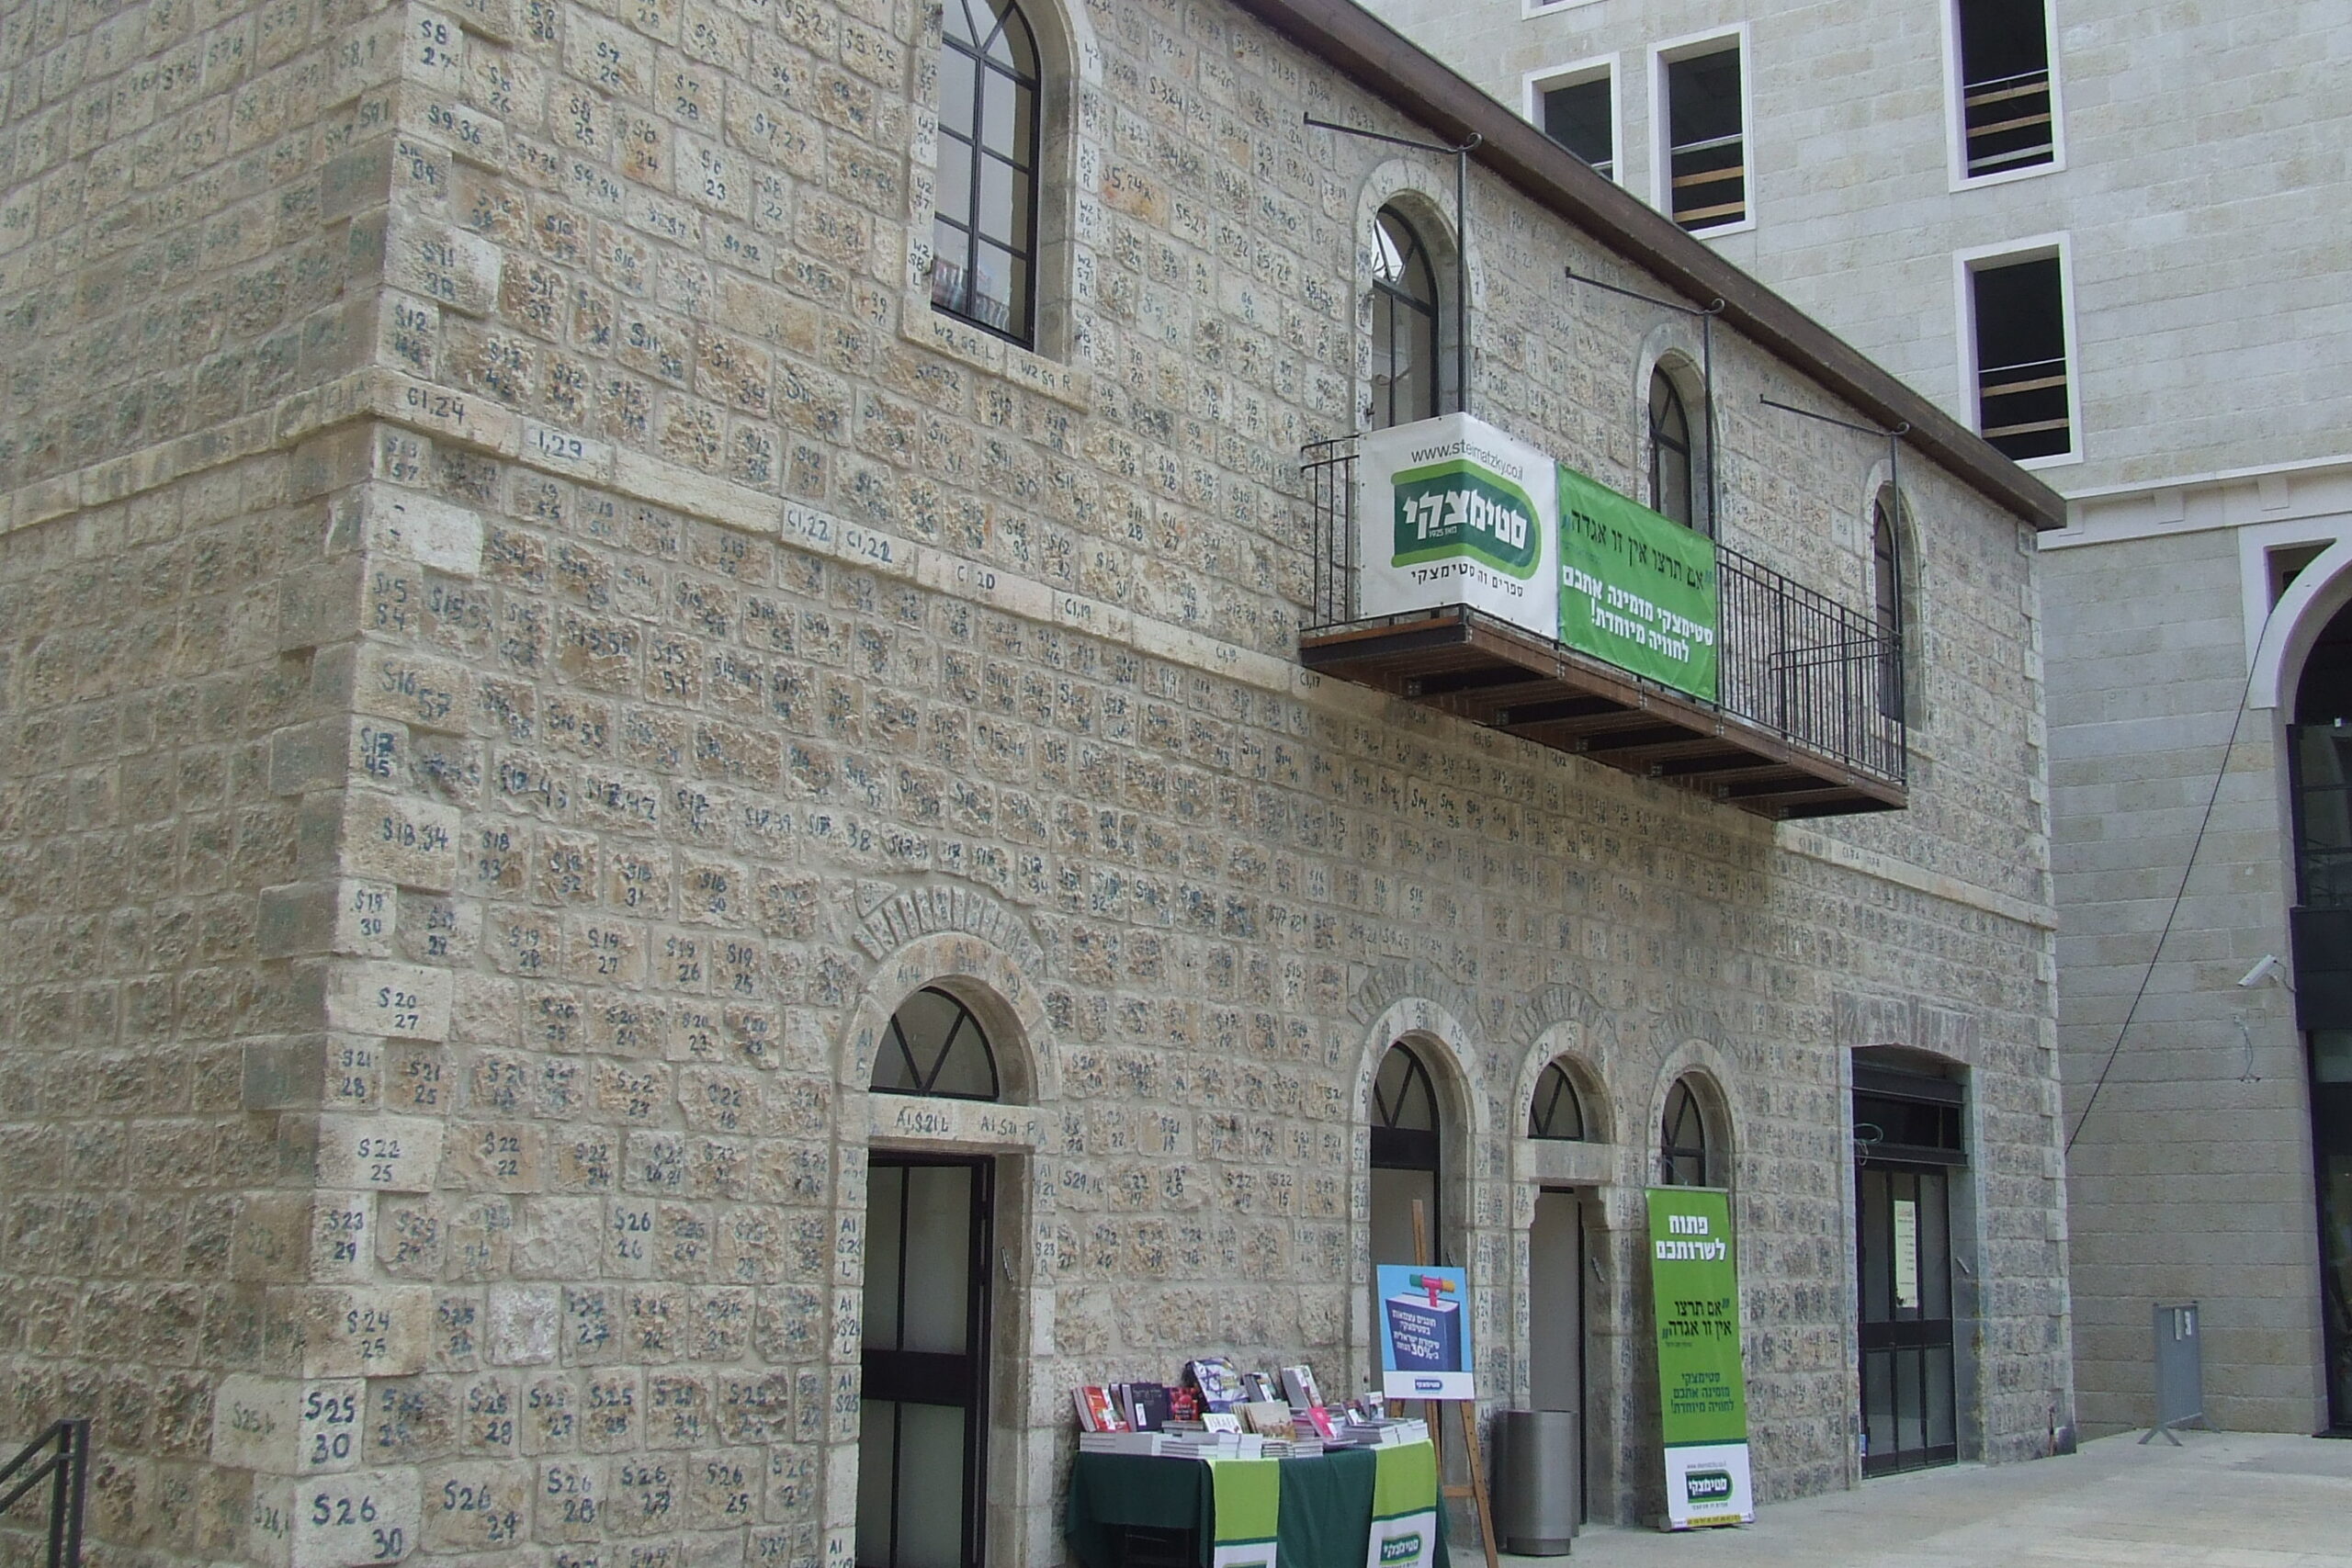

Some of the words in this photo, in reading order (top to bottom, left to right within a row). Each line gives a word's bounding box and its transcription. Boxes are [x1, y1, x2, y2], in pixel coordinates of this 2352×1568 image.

[422, 20, 447, 44] S8
[675, 96, 698, 120] 28
[706, 179, 726, 201] 23
[1021, 359, 1037, 378] W2
[1411, 439, 1523, 481] www.steimatzky.co.il
[1402, 489, 1528, 549] סטימצקי
[1628, 536, 1647, 567] אין
[1411, 563, 1475, 585] סטימצקי
[1563, 565, 1602, 600] אתכם
[1492, 579, 1523, 597] ספרים
[1657, 607, 1713, 646] סטימצקי
[479, 859, 501, 882] 33
[360, 919, 382, 936] 30
[598, 956, 617, 975] 27
[379, 987, 417, 1008] S20
[394, 1013, 419, 1031] 27
[689, 1034, 707, 1051] 23
[343, 1049, 371, 1067] S21
[410, 1061, 441, 1081] S21
[341, 1077, 366, 1098] 28
[415, 1085, 436, 1104] 25
[357, 1138, 400, 1158] S22
[485, 1132, 520, 1155] S22
[370, 1164, 392, 1182] 25
[497, 1159, 518, 1177] 22
[1668, 1215, 1709, 1235] פתוח
[1656, 1238, 1726, 1260] לשרותכם
[1675, 1301, 1704, 1315] תרצו
[347, 1310, 390, 1334] S24
[1714, 1321, 1732, 1341] אין
[362, 1337, 387, 1359] 25
[305, 1392, 356, 1424] S25
[311, 1433, 350, 1464] 30
[548, 1468, 592, 1495] S26
[1688, 1477, 1726, 1495] סטימצקי
[443, 1480, 492, 1510] S26
[727, 1493, 749, 1514] 25
[312, 1494, 377, 1525] S26
[563, 1498, 595, 1523] 28
[372, 1528, 402, 1559] 30
